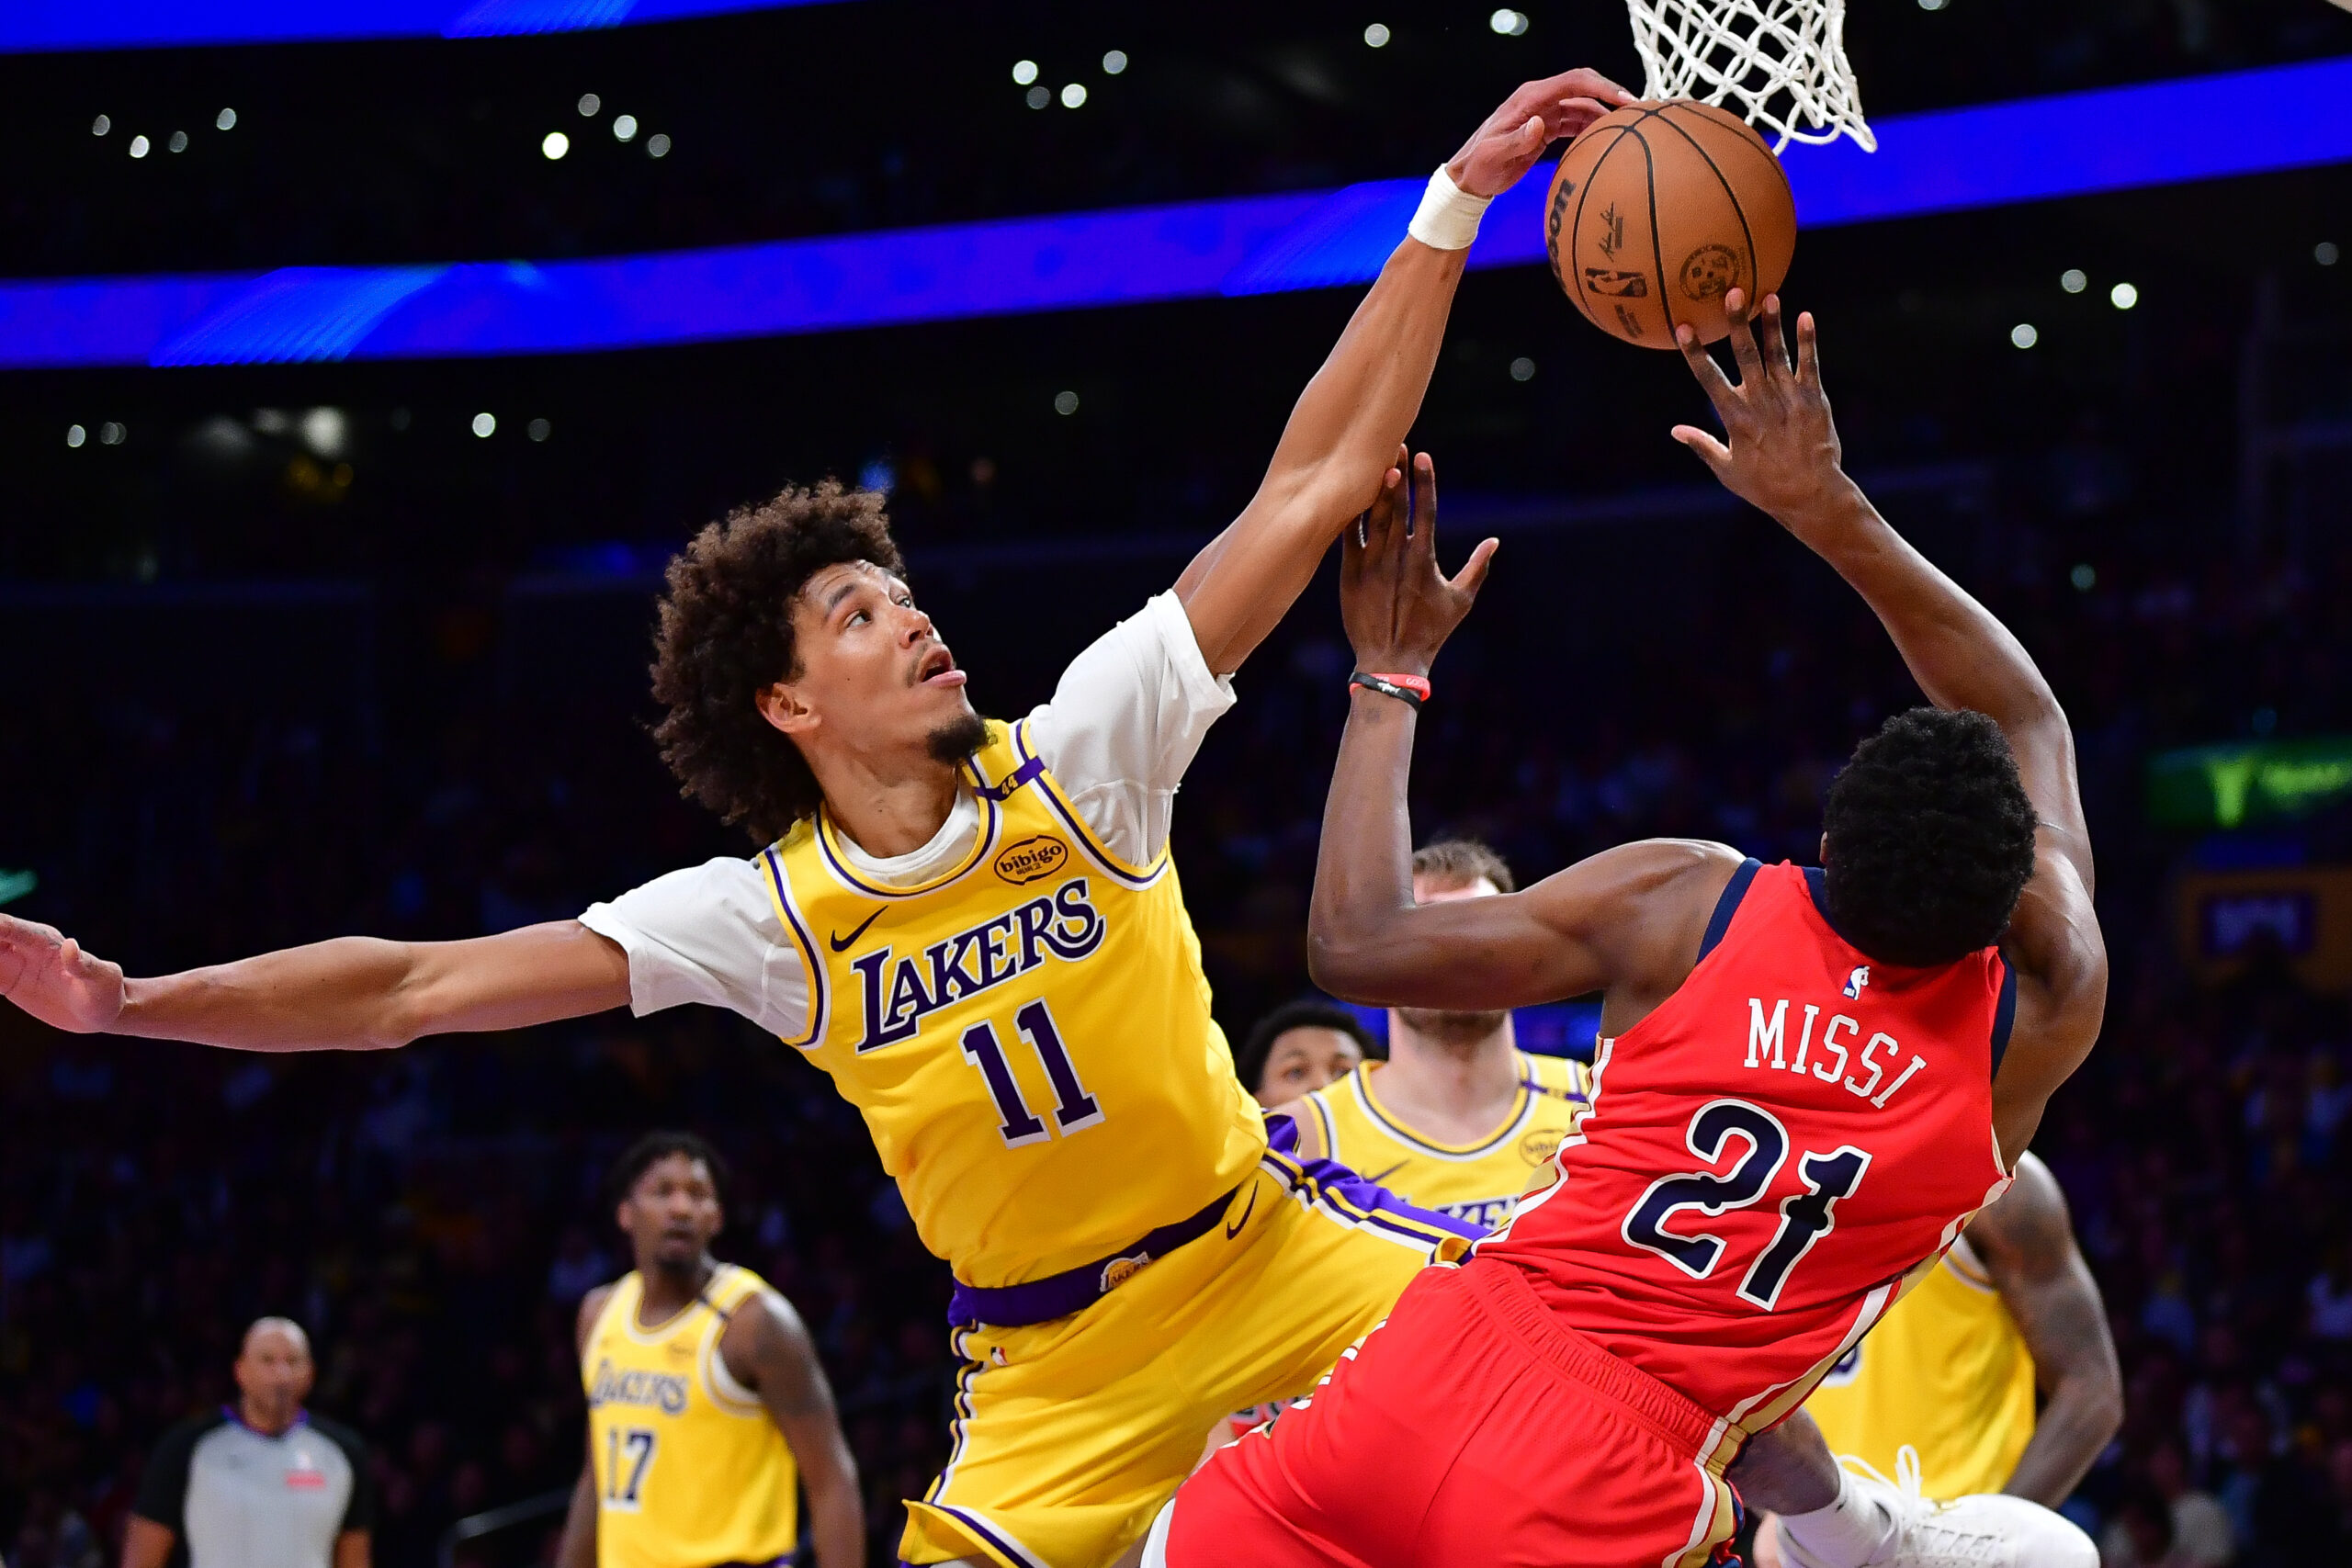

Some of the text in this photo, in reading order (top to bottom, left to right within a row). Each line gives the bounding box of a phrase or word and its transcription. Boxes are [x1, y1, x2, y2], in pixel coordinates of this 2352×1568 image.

[1001, 774, 1019, 795] 44
[1000, 845, 1062, 873] bibigo
[850, 877, 1107, 1055] LAKERS
[958, 997, 1105, 1149] 11
[1744, 998, 1927, 1109] MISSI
[1621, 1099, 1872, 1312] 21
[603, 1426, 656, 1512] 17
